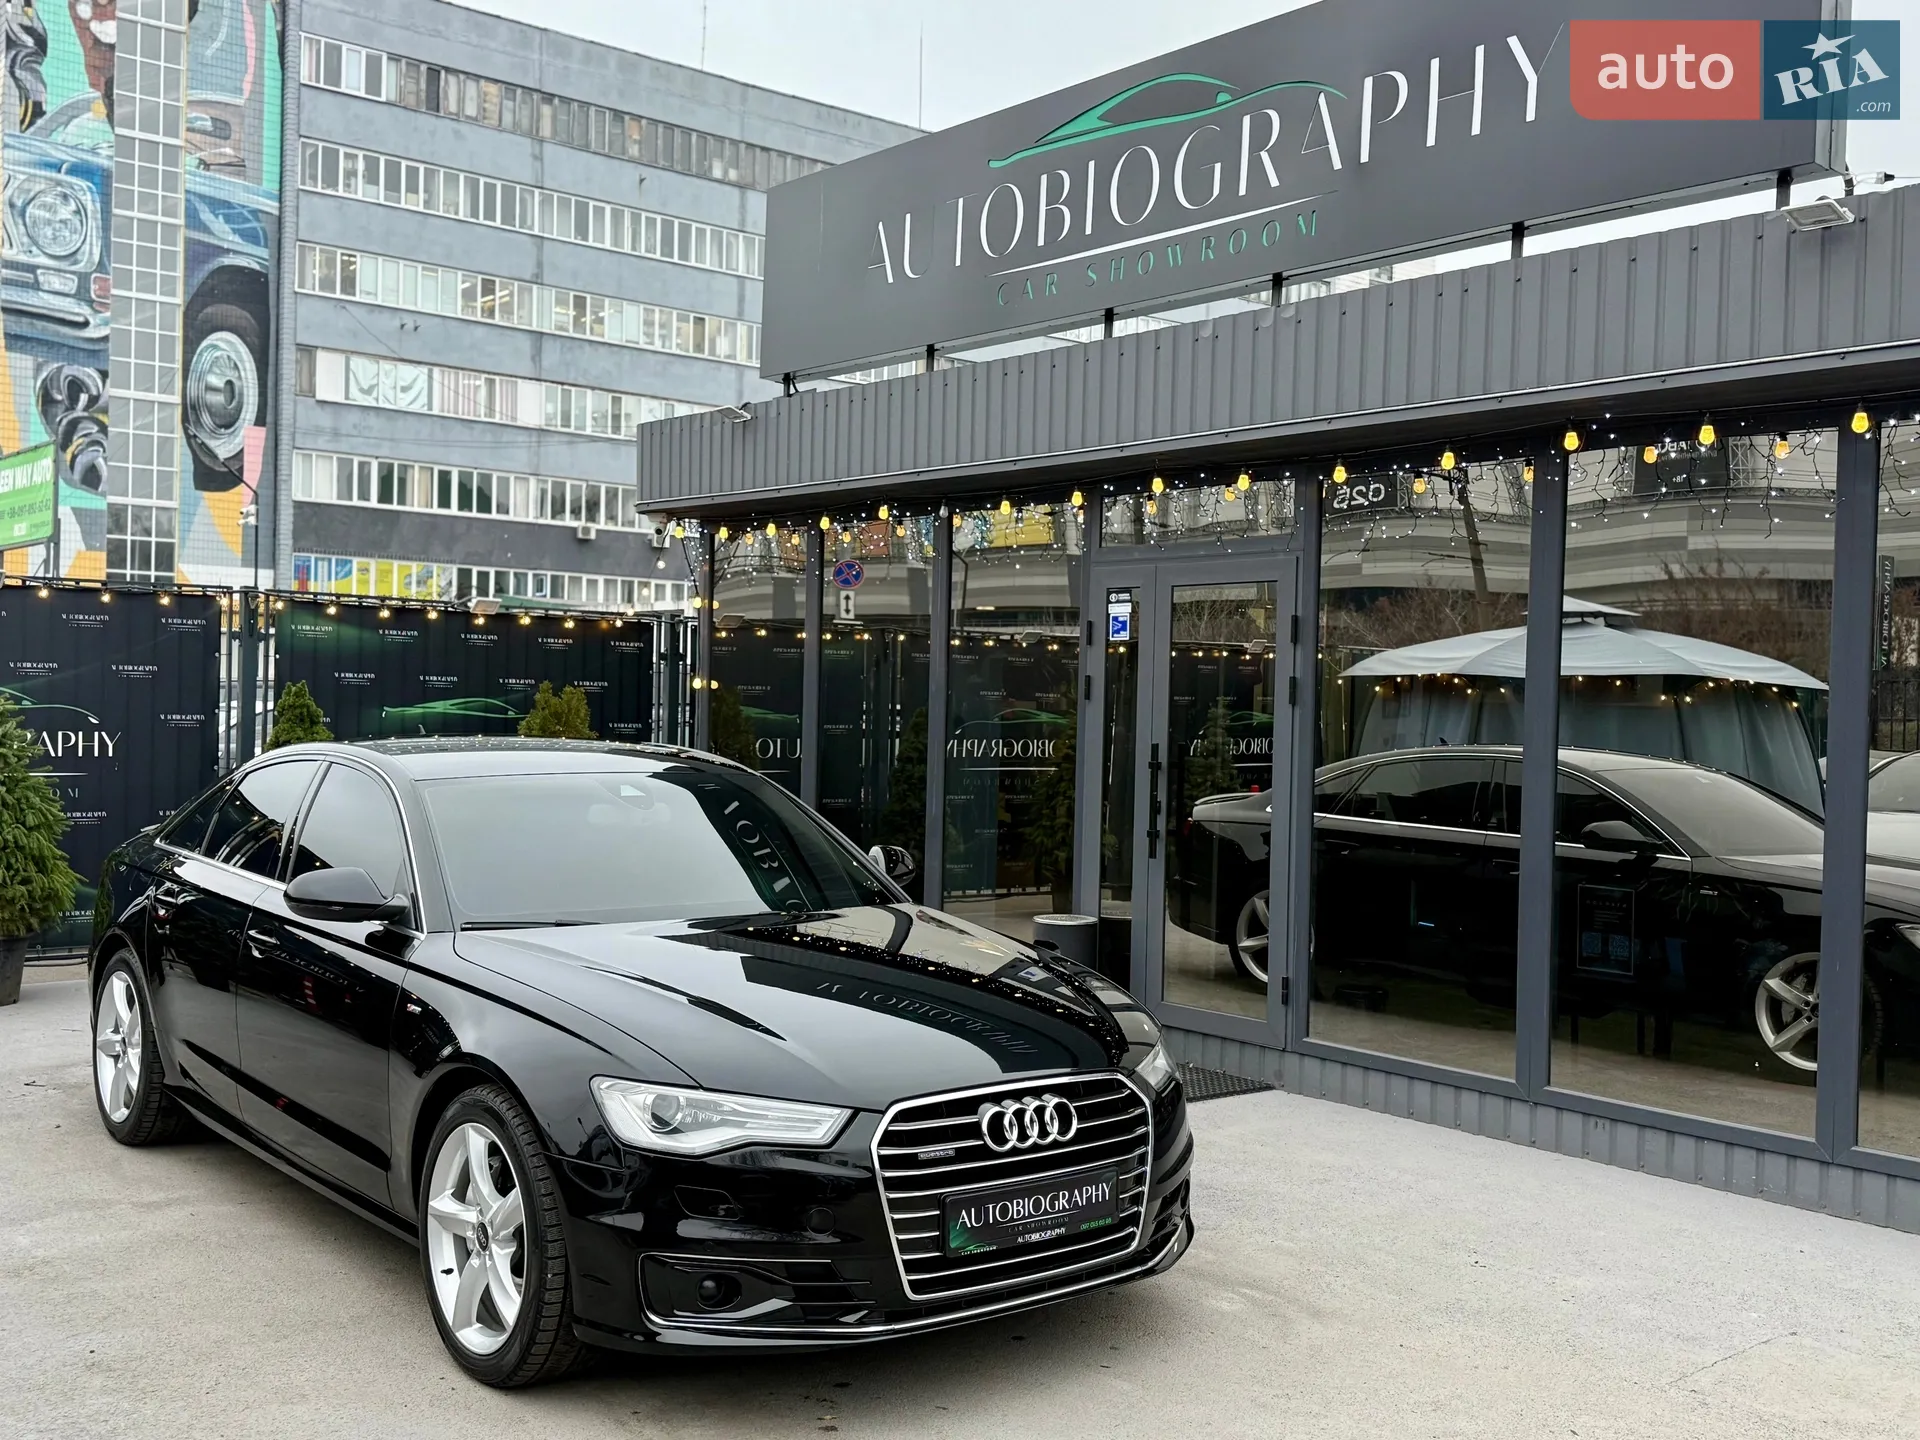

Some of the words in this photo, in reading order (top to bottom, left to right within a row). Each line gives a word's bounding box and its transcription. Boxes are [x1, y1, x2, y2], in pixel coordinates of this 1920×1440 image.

[866, 22, 1565, 284] AUTOBIOGRAPHY
[997, 271, 1058, 306] CAR
[1085, 210, 1317, 287] SHOWROOM
[15, 462, 33, 490] WAY
[32, 456, 52, 486] AUTO
[956, 1181, 1112, 1230] AUTOBIOGRAPHY
[1016, 1227, 1067, 1244] AUTOBIOGRAPHY
